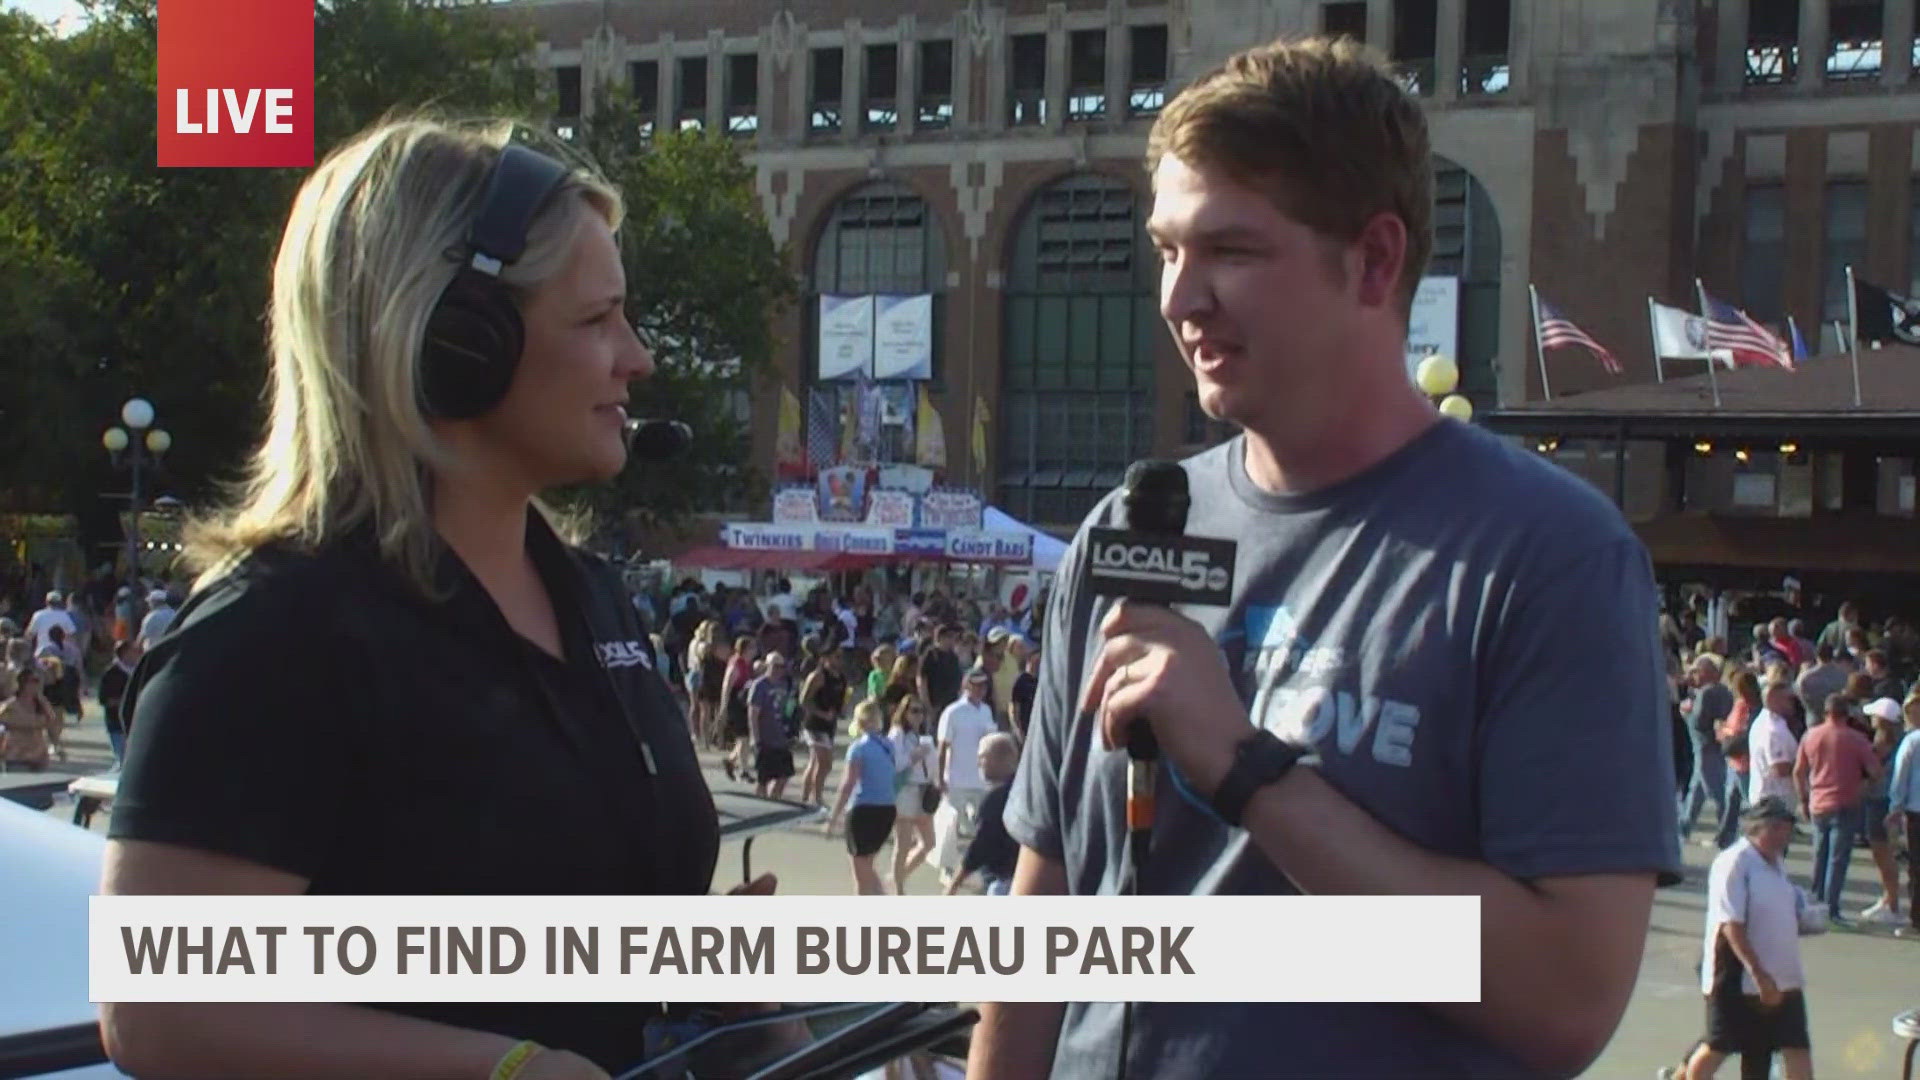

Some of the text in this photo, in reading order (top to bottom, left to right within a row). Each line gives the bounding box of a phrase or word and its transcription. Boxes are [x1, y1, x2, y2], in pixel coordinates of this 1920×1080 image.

[732, 529, 803, 547] TWINKIES
[951, 537, 992, 554] CANDY
[994, 539, 1024, 556] BARS
